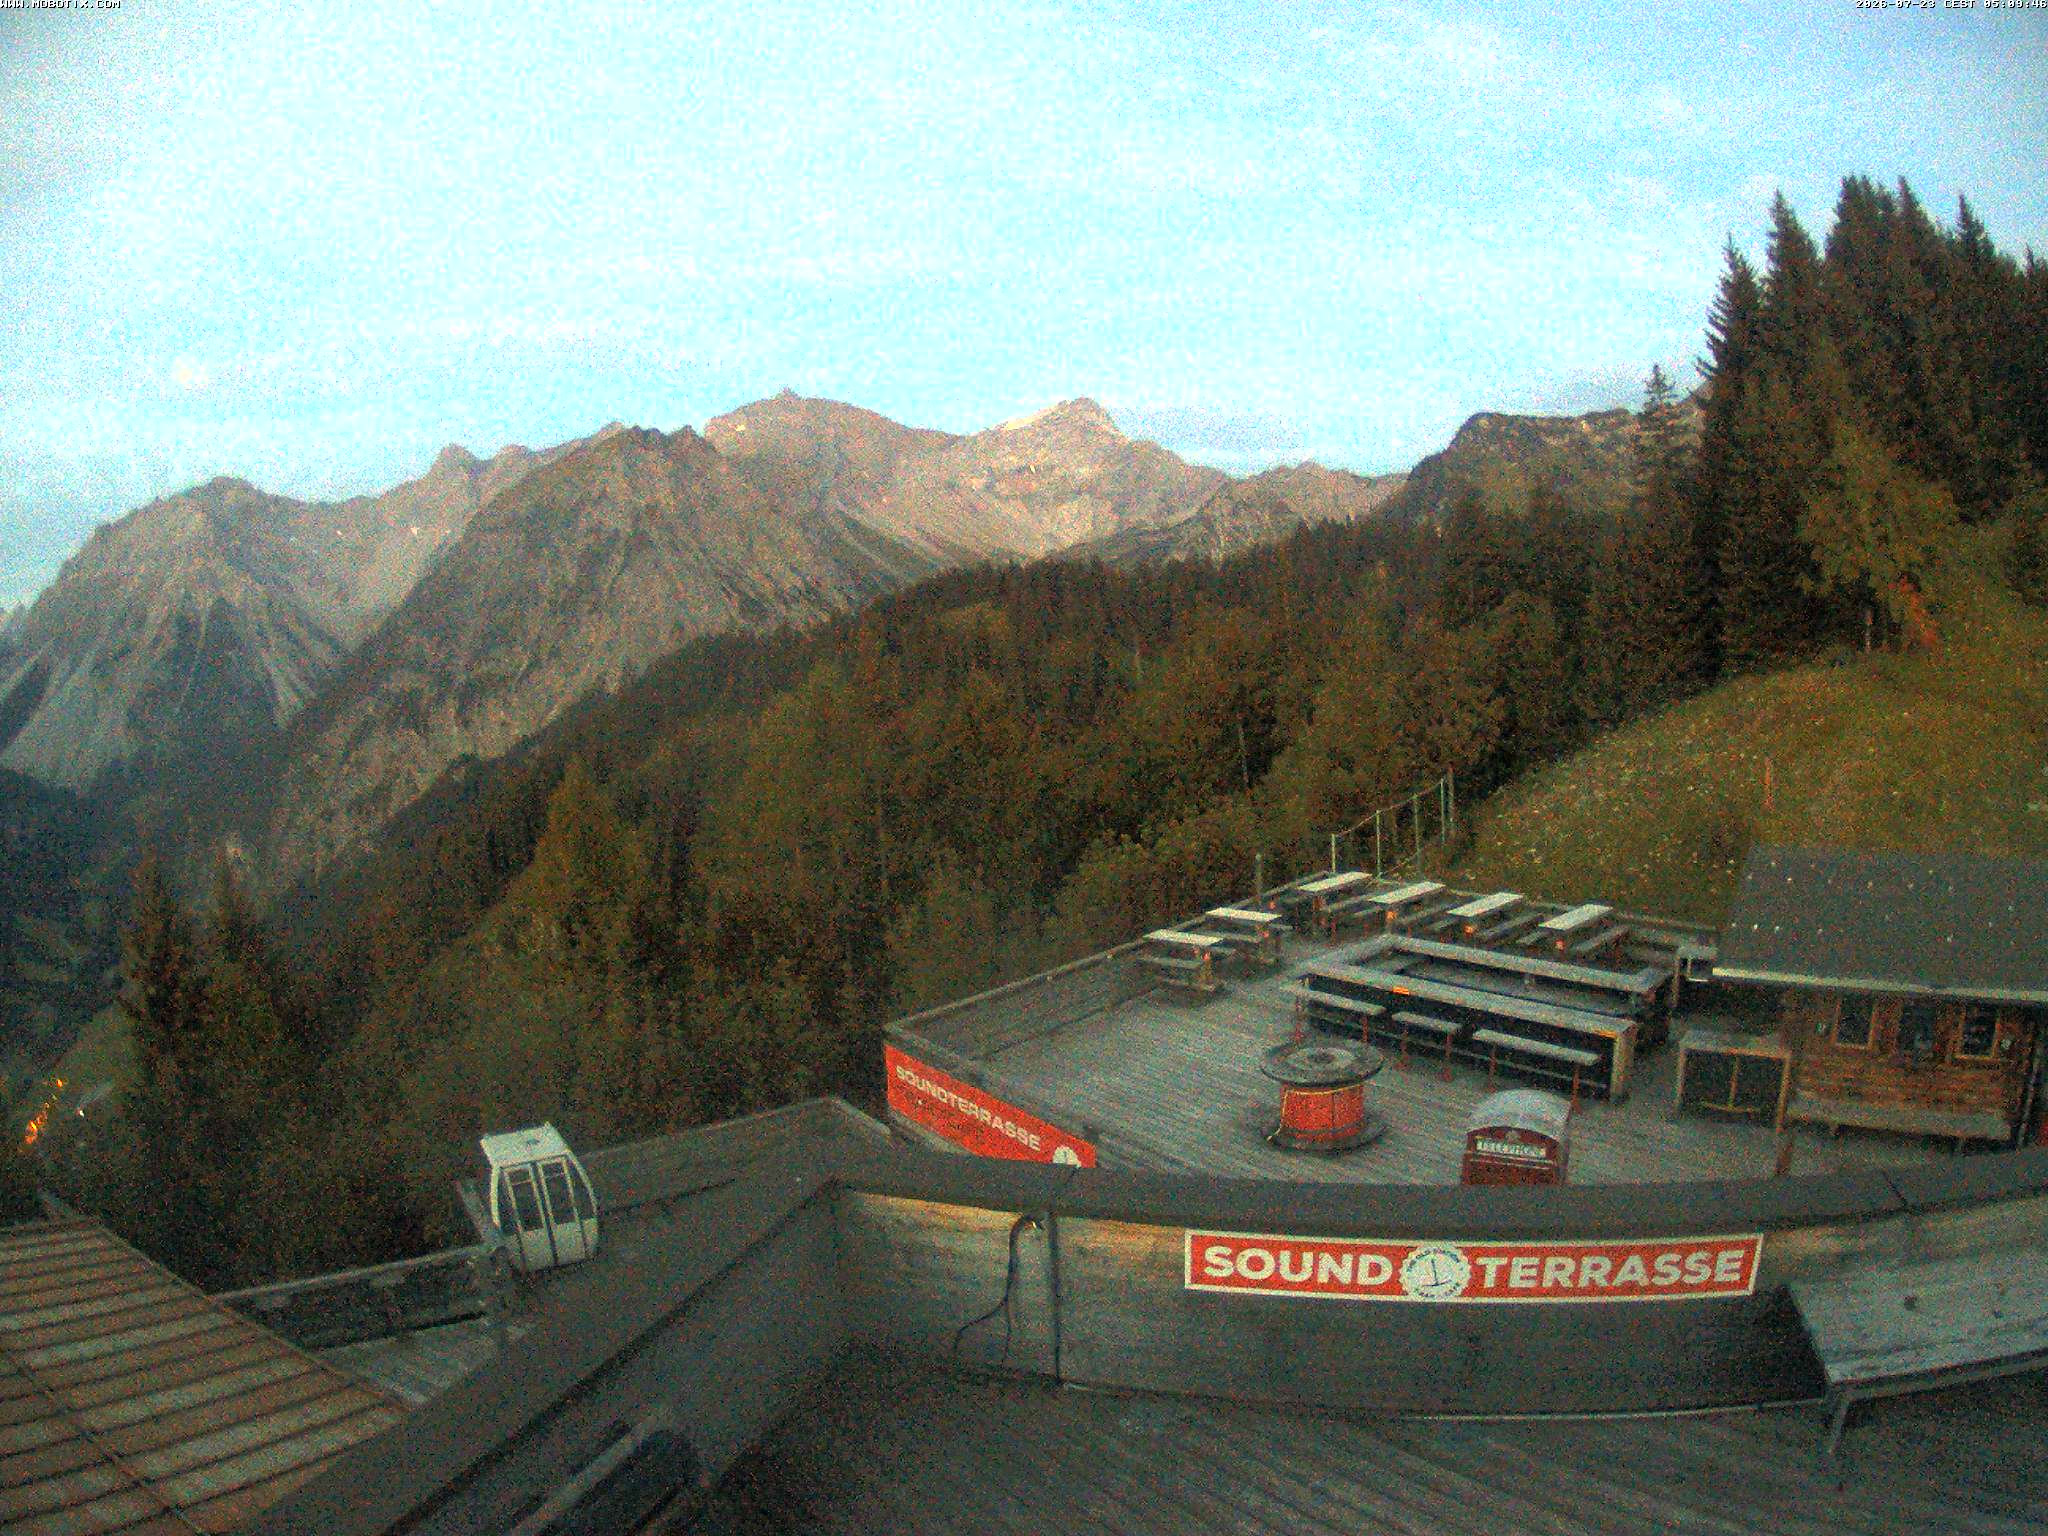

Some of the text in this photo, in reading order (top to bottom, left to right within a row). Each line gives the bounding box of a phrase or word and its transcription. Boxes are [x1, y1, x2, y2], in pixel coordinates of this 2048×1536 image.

[895, 1065, 1041, 1151] SOUNDTERRASSE
[1203, 1245, 1392, 1286] SOUND
[1476, 1249, 1743, 1291] TERRASSE
